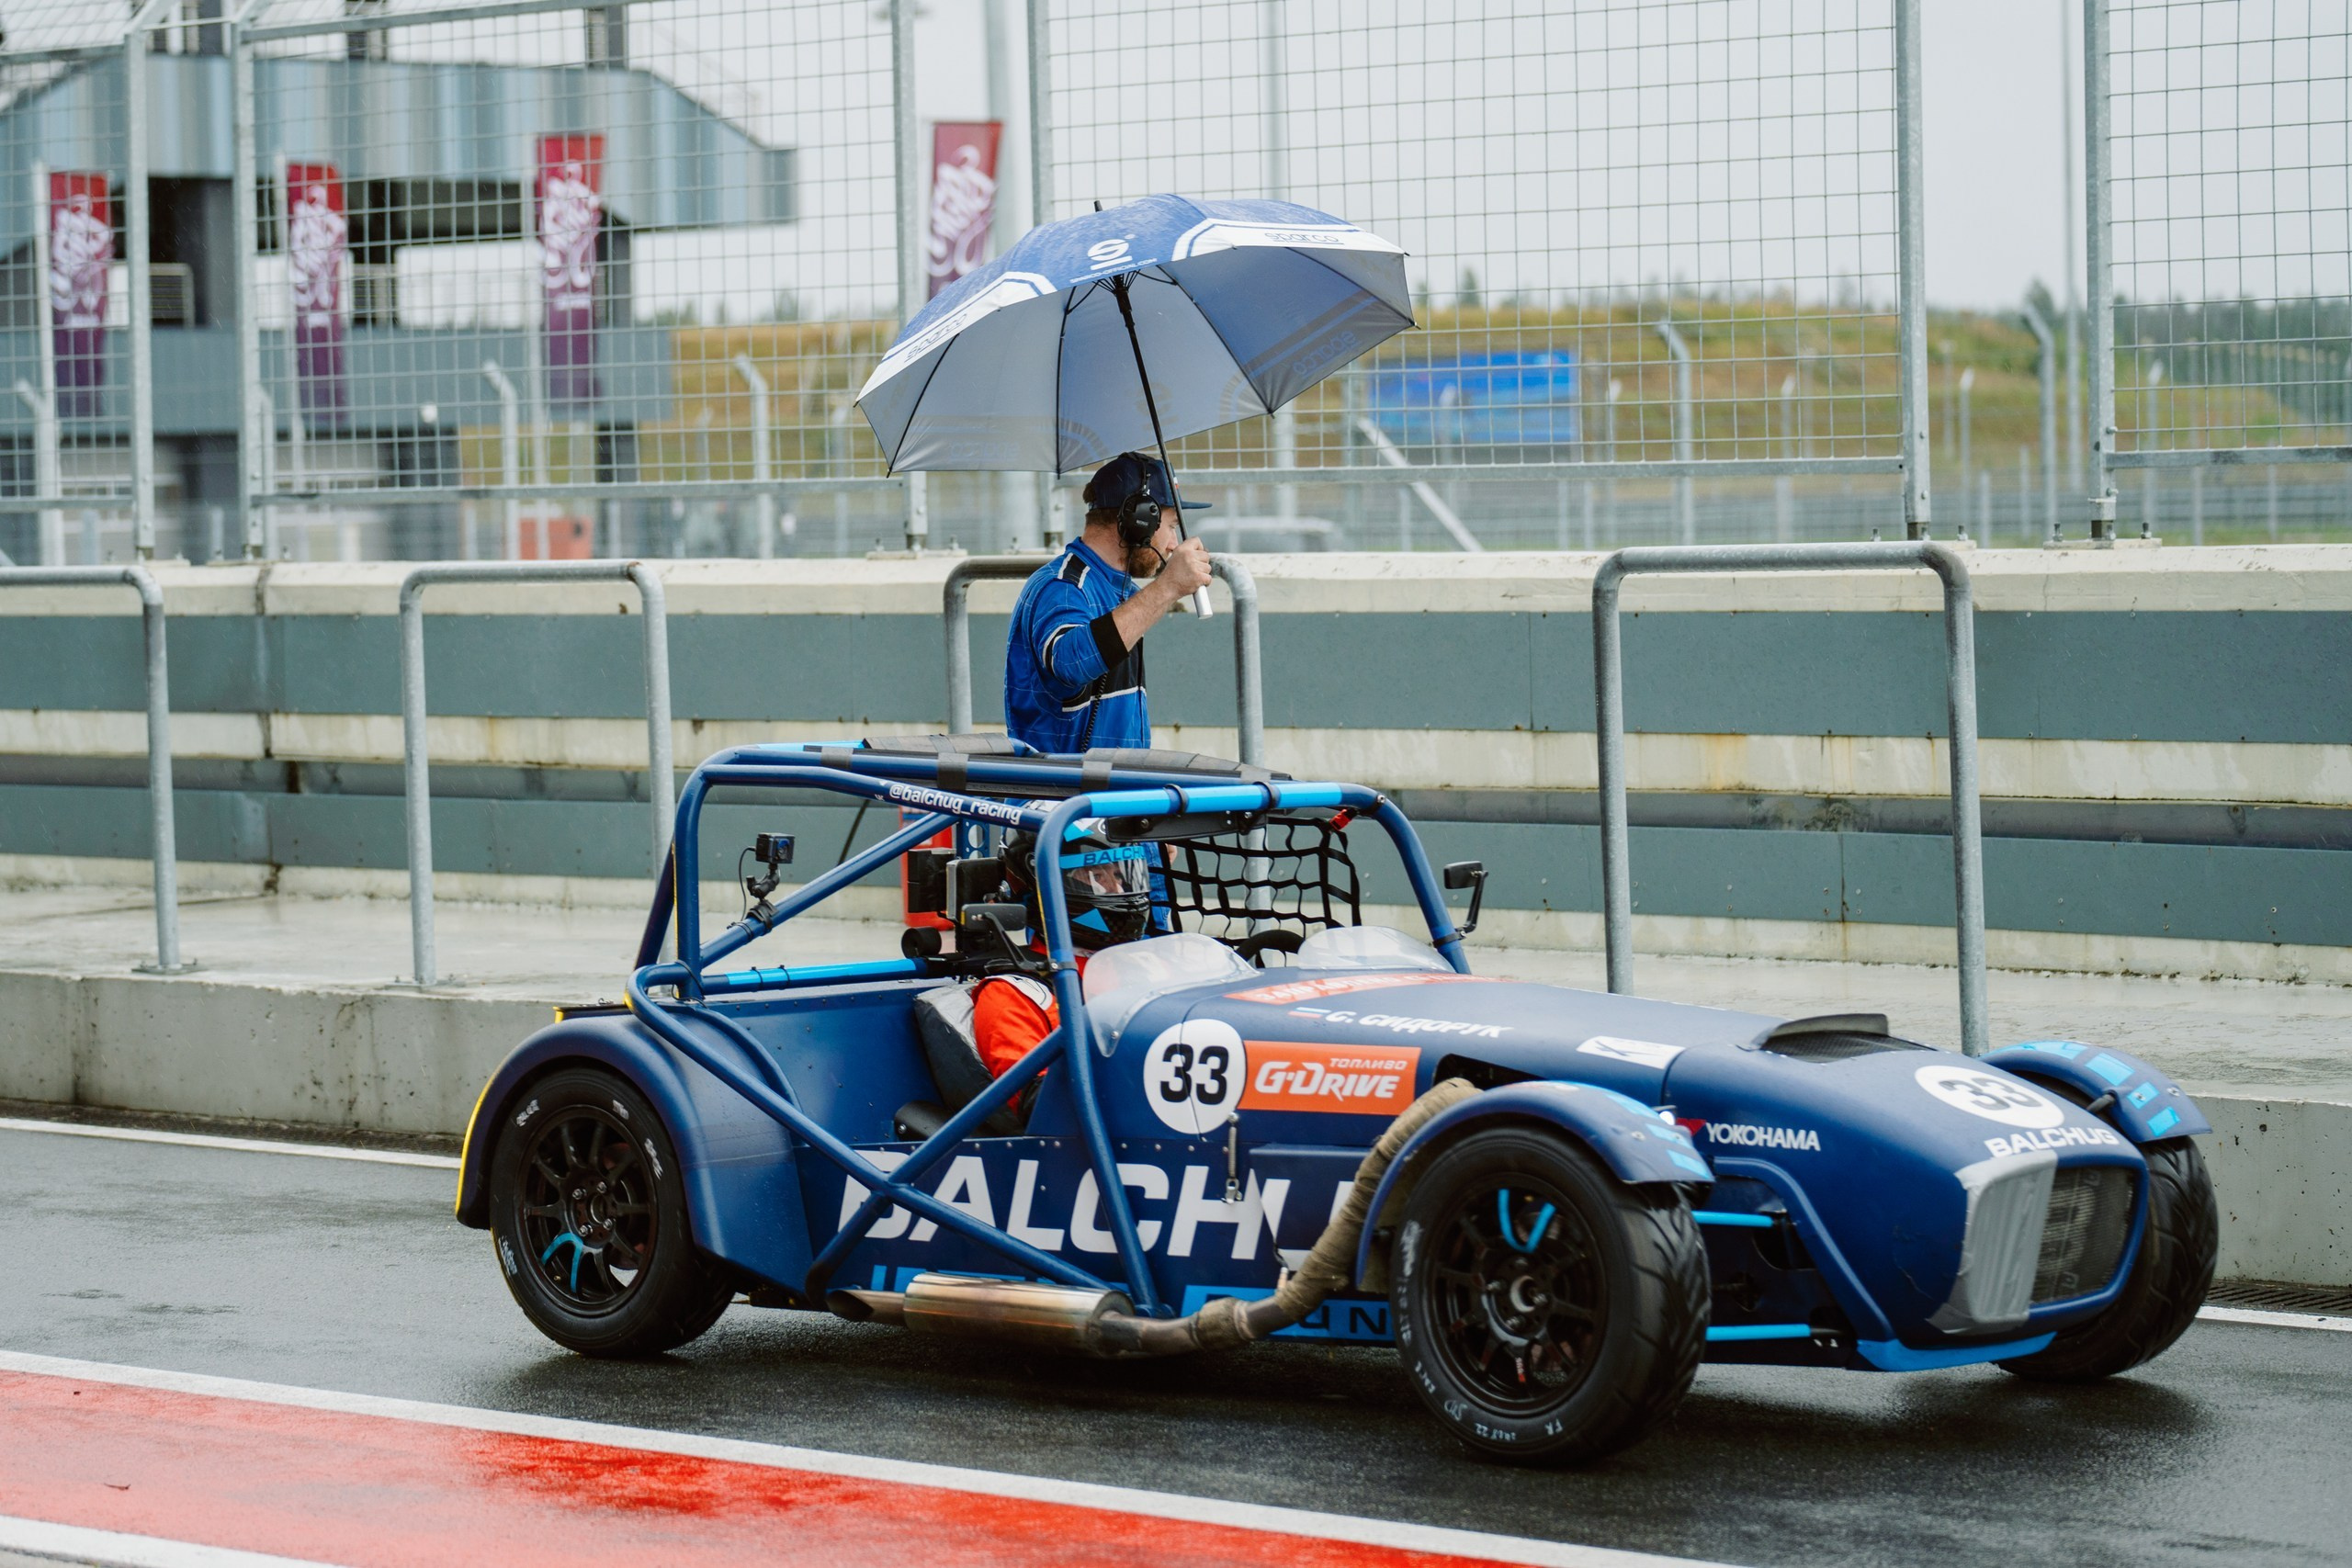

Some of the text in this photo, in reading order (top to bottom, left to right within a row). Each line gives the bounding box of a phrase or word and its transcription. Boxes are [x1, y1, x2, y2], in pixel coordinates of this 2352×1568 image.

[1264, 232, 1340, 243] sparco
[889, 784, 1023, 825] @balchug_racing
[1358, 1013, 1515, 1038] СИДОРУК
[1159, 1043, 1229, 1105] 33
[1329, 1057, 1408, 1071] ТОПЛИВО
[1939, 1077, 2042, 1111] 33
[1705, 1122, 1821, 1152] YOKOHAMA
[1984, 1127, 2120, 1158] BALCHUG
